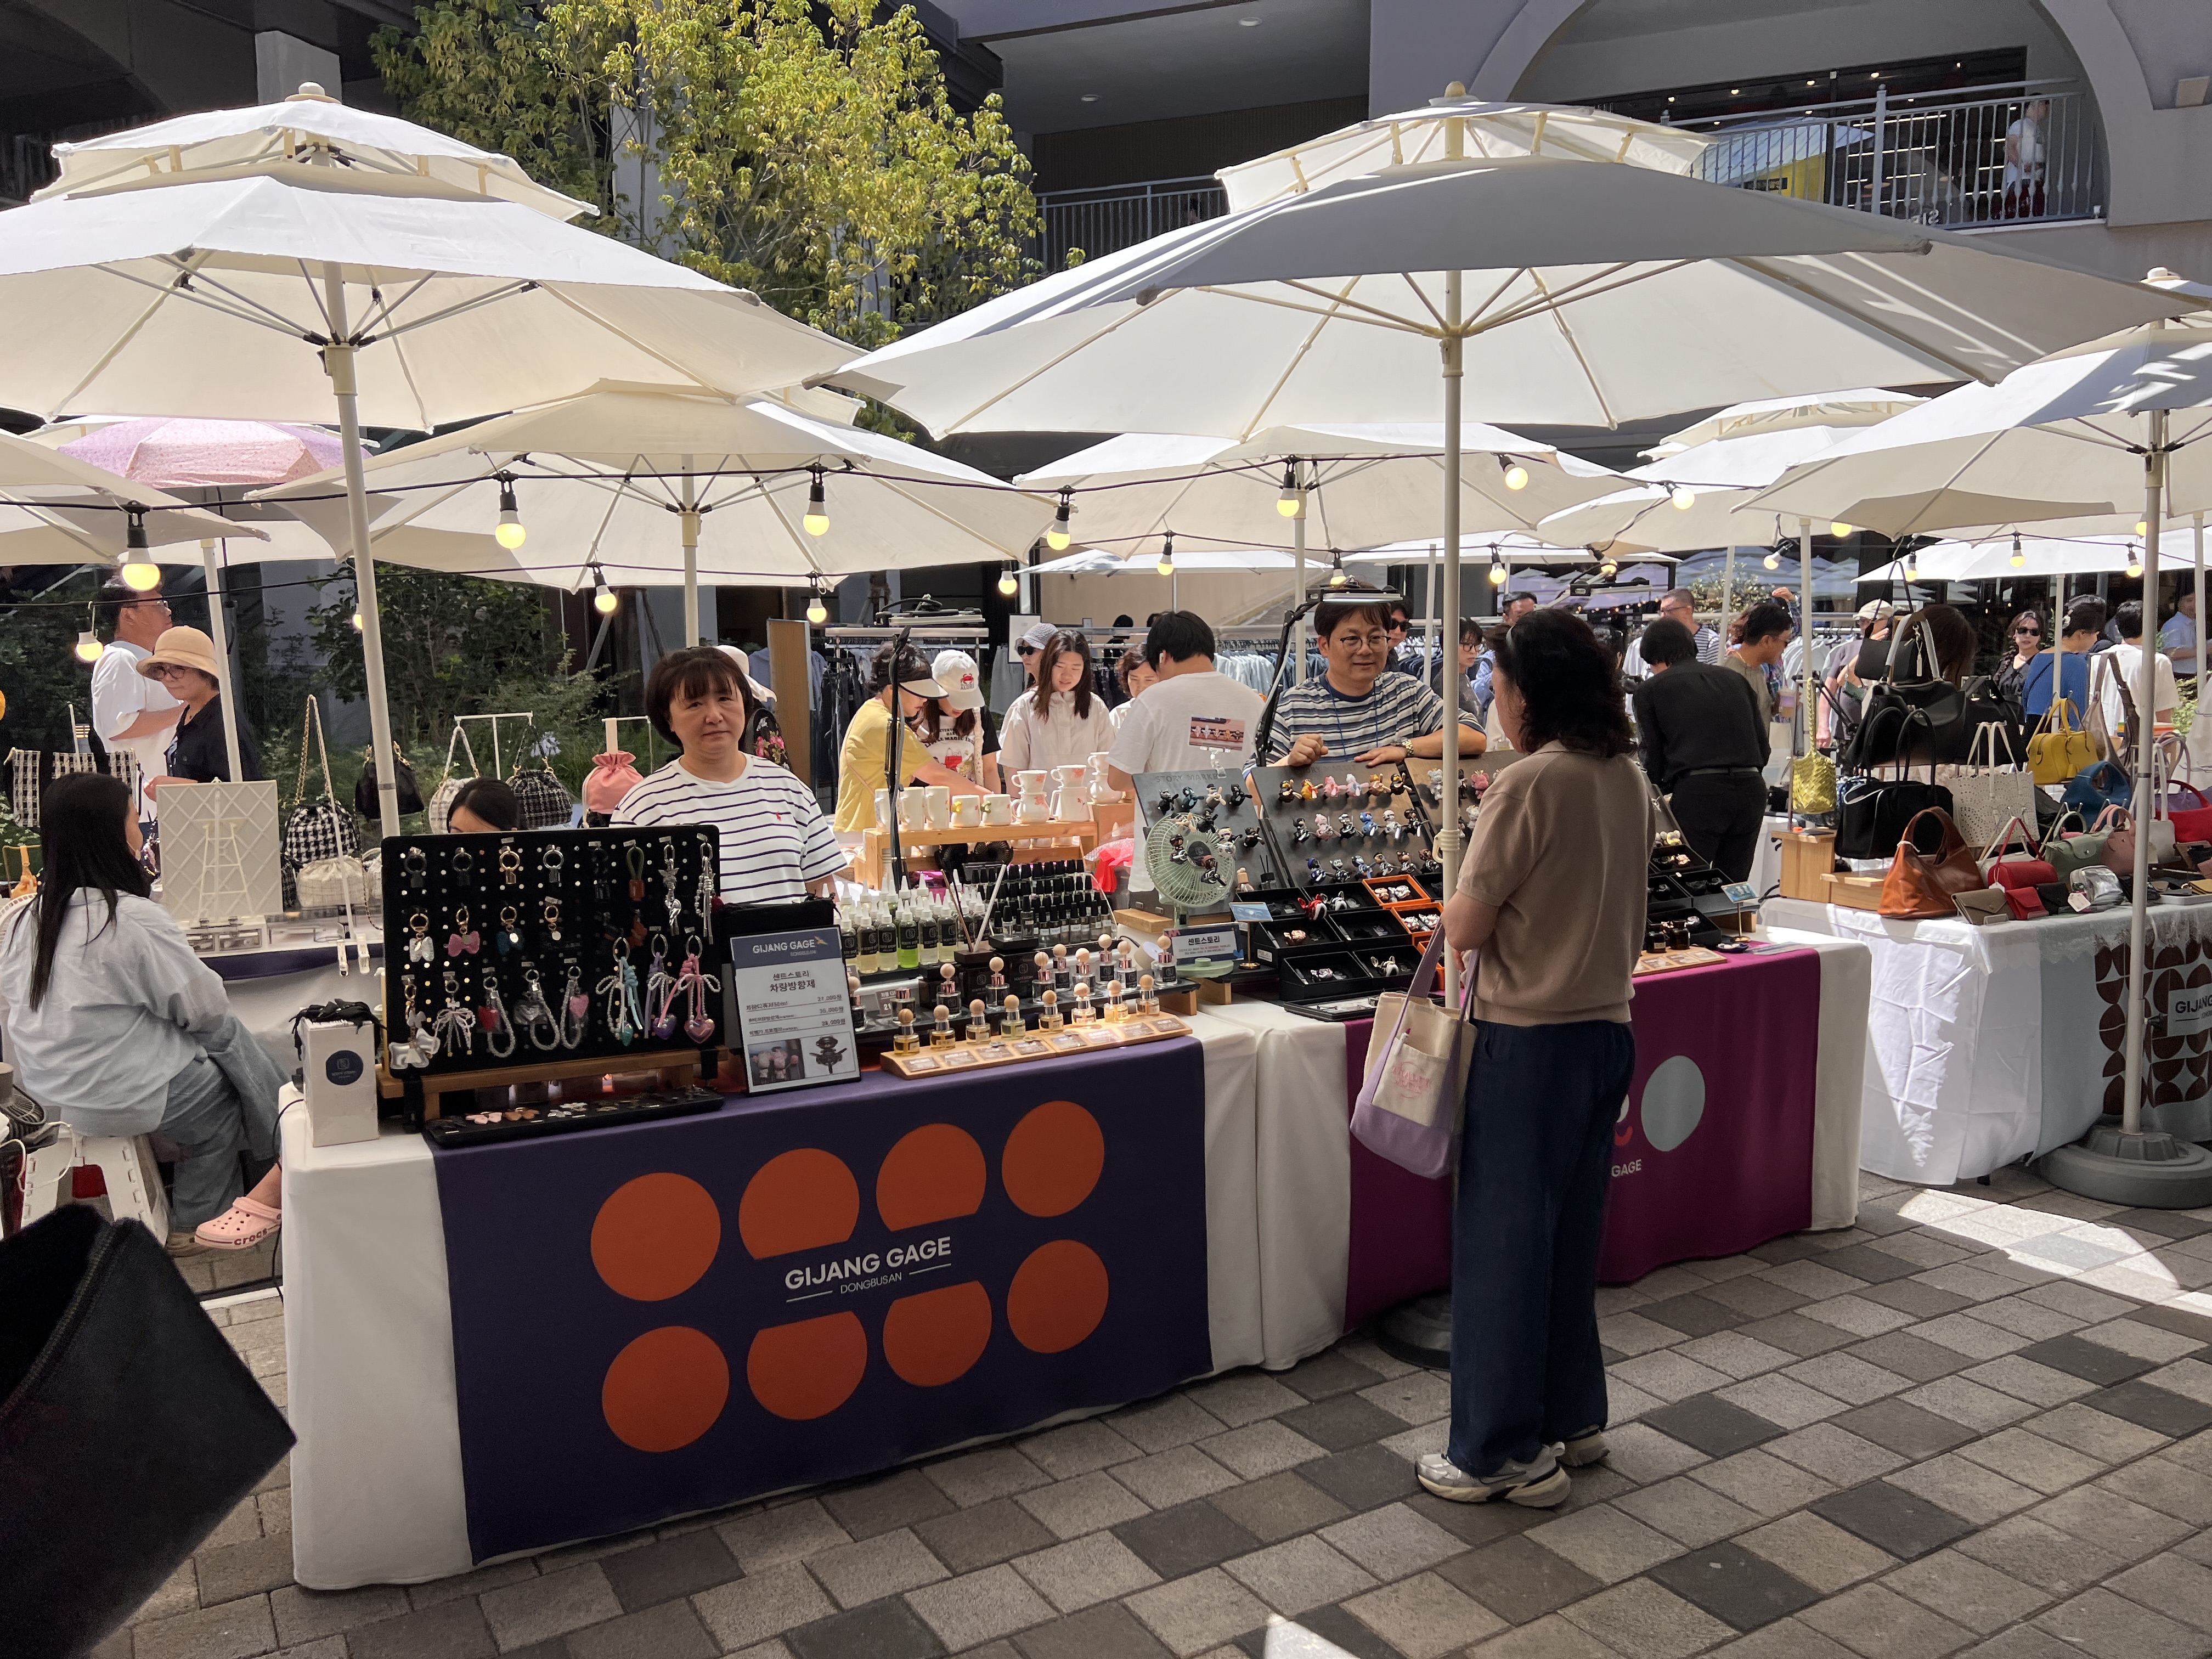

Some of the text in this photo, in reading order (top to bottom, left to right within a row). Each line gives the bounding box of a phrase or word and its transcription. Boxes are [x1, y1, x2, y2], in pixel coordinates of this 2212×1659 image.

[1155, 772, 1218, 783] STORY MARKE
[753, 939, 816, 953] GIJANG GAGE
[1188, 935, 1220, 945] 센트스토리
[773, 970, 810, 981] 센트스토리
[770, 979, 816, 992] 차량방향제
[1611, 1159, 1642, 1177] GAGE
[234, 1228, 268, 1245] crocs
[785, 1236, 952, 1290] GIJANG GAGE
[840, 1272, 902, 1294] DONGBUSAN
